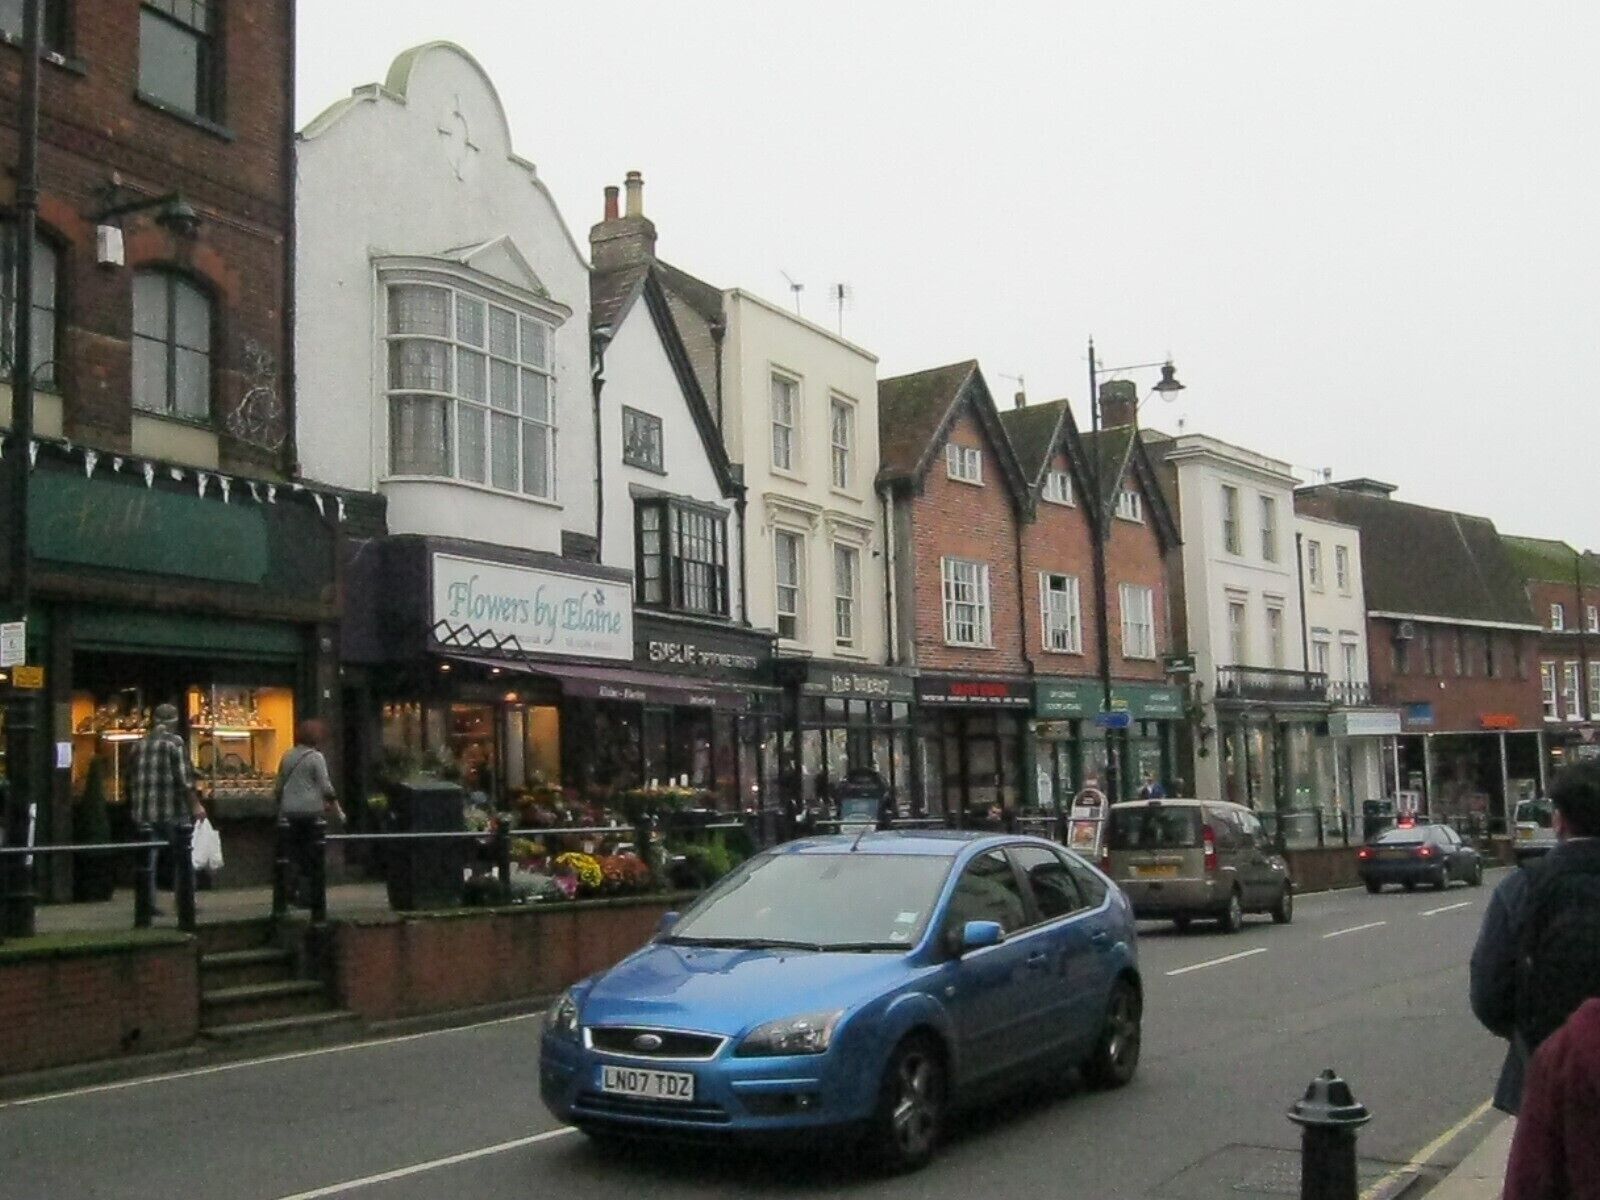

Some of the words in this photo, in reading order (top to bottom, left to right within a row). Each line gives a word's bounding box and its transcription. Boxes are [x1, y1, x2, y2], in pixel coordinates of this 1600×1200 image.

[448, 575, 529, 624] Flowers
[535, 584, 558, 645] by
[562, 590, 622, 634] Elaine
[604, 1069, 650, 1093] LN07
[655, 1074, 690, 1097] TDZ
